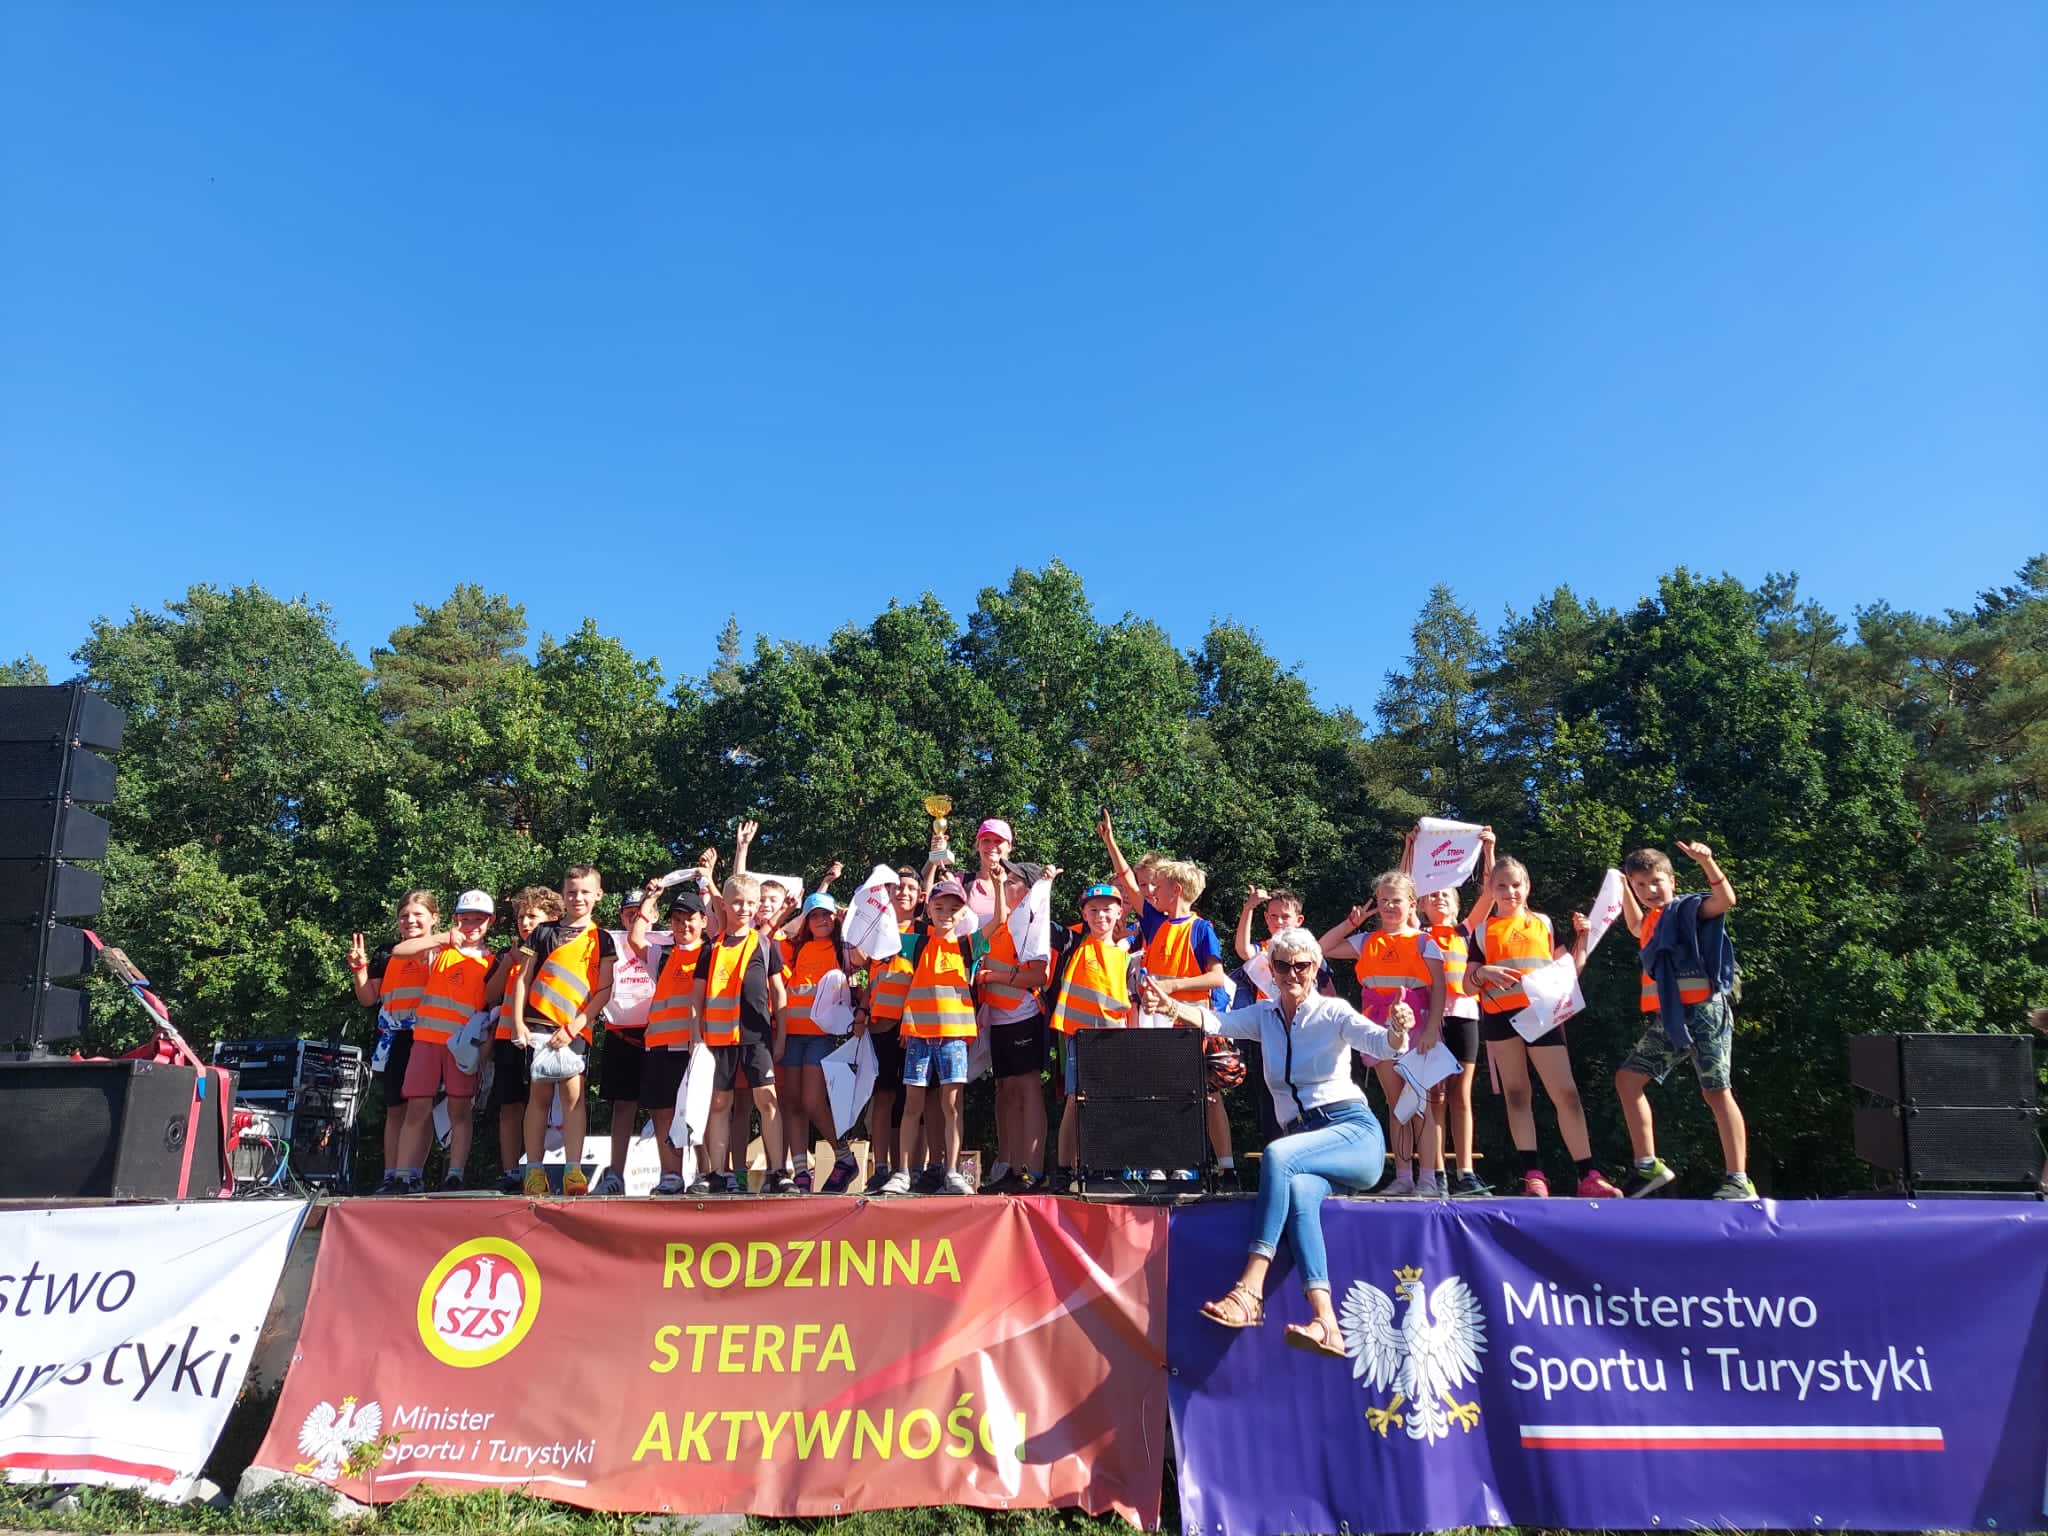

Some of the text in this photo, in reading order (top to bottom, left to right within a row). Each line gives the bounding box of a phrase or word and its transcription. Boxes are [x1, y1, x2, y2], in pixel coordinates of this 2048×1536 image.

[663, 1239, 961, 1288] RODZINNA
[440, 1306, 511, 1339] SZS
[1502, 1281, 1818, 1328] Ministerstwo
[649, 1324, 856, 1373] STERFA
[1510, 1345, 1933, 1401] Sportu i Turystyki
[392, 1405, 495, 1431] Minister
[382, 1440, 597, 1470] Sportu i Turystyki
